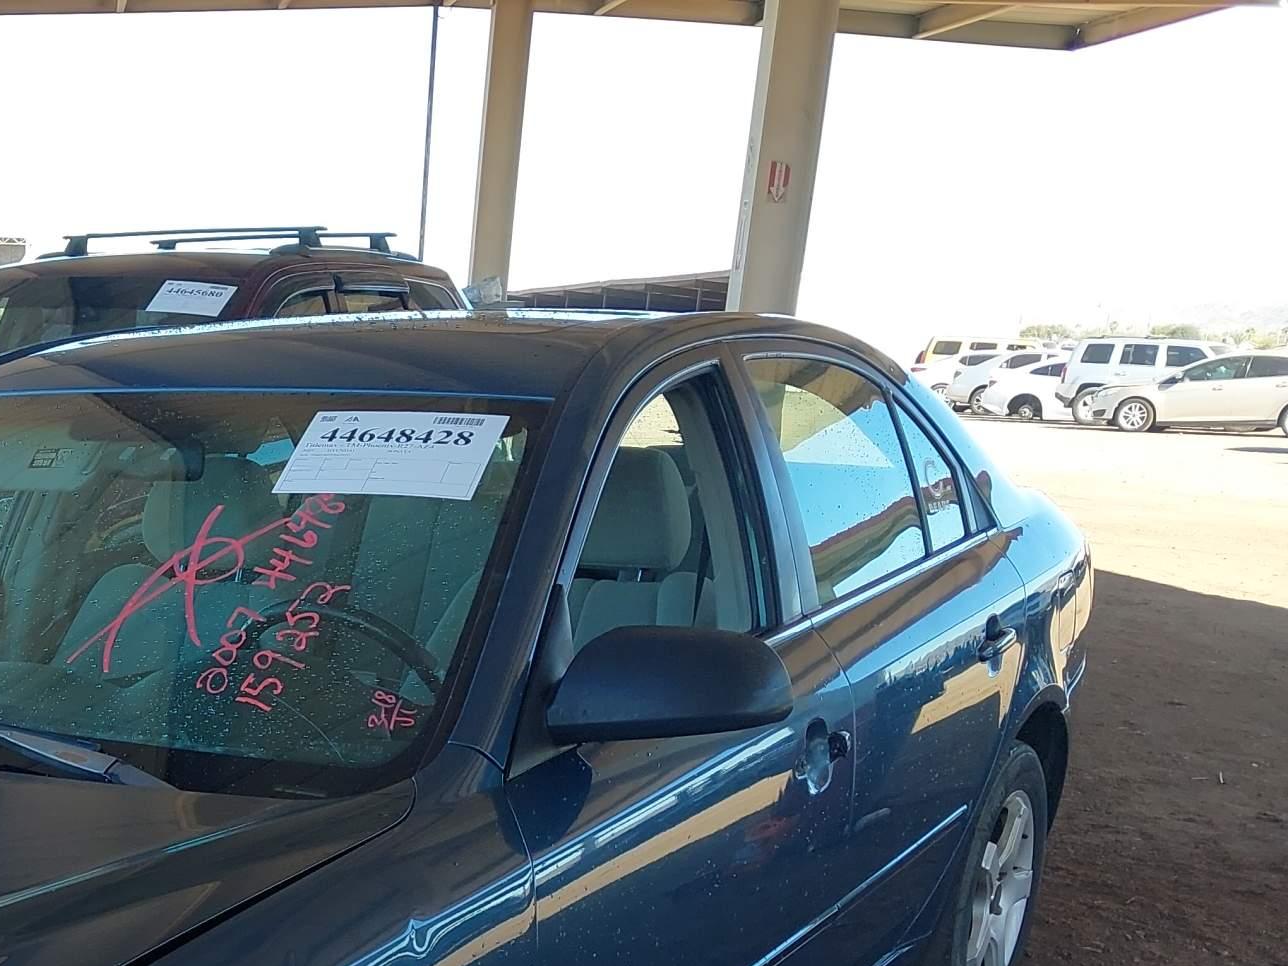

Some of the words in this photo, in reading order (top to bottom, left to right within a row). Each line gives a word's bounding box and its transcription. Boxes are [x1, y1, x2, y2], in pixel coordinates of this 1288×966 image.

[320, 427, 475, 447] 44648428
[196, 607, 267, 694] 2007
[235, 582, 352, 712] 159252
